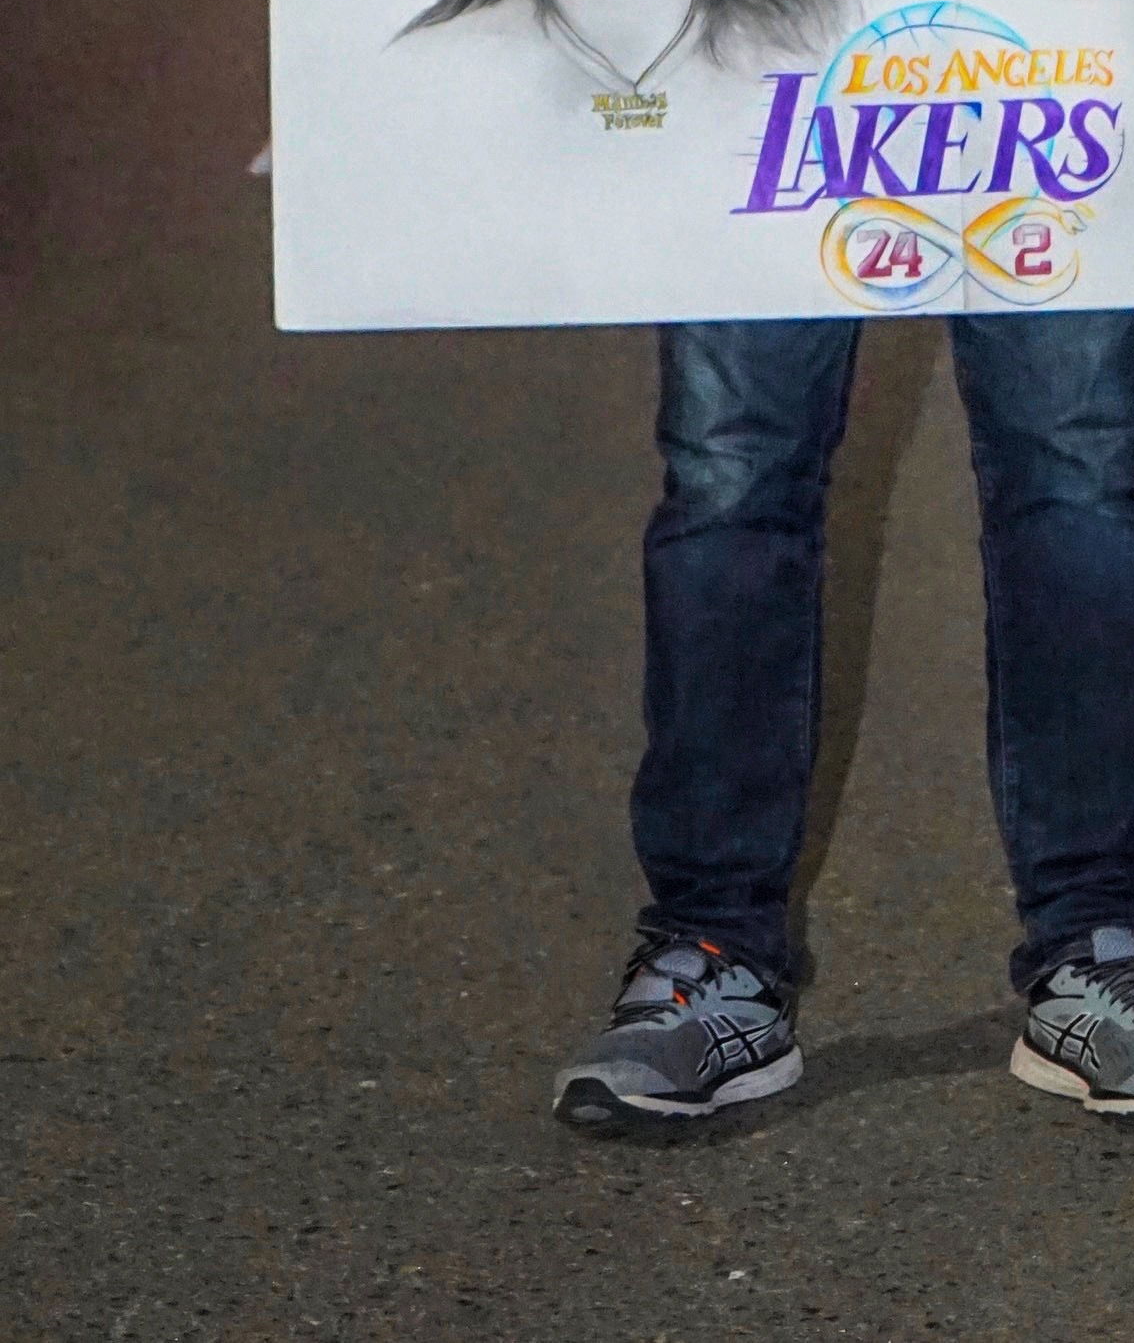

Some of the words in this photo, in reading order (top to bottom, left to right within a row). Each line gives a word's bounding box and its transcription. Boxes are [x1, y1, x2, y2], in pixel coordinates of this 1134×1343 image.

[842, 54, 930, 95] LOS
[935, 48, 1114, 93] ANGELES
[730, 72, 1125, 214] LAKERS
[857, 228, 923, 278] 24
[1012, 224, 1052, 276] 2
